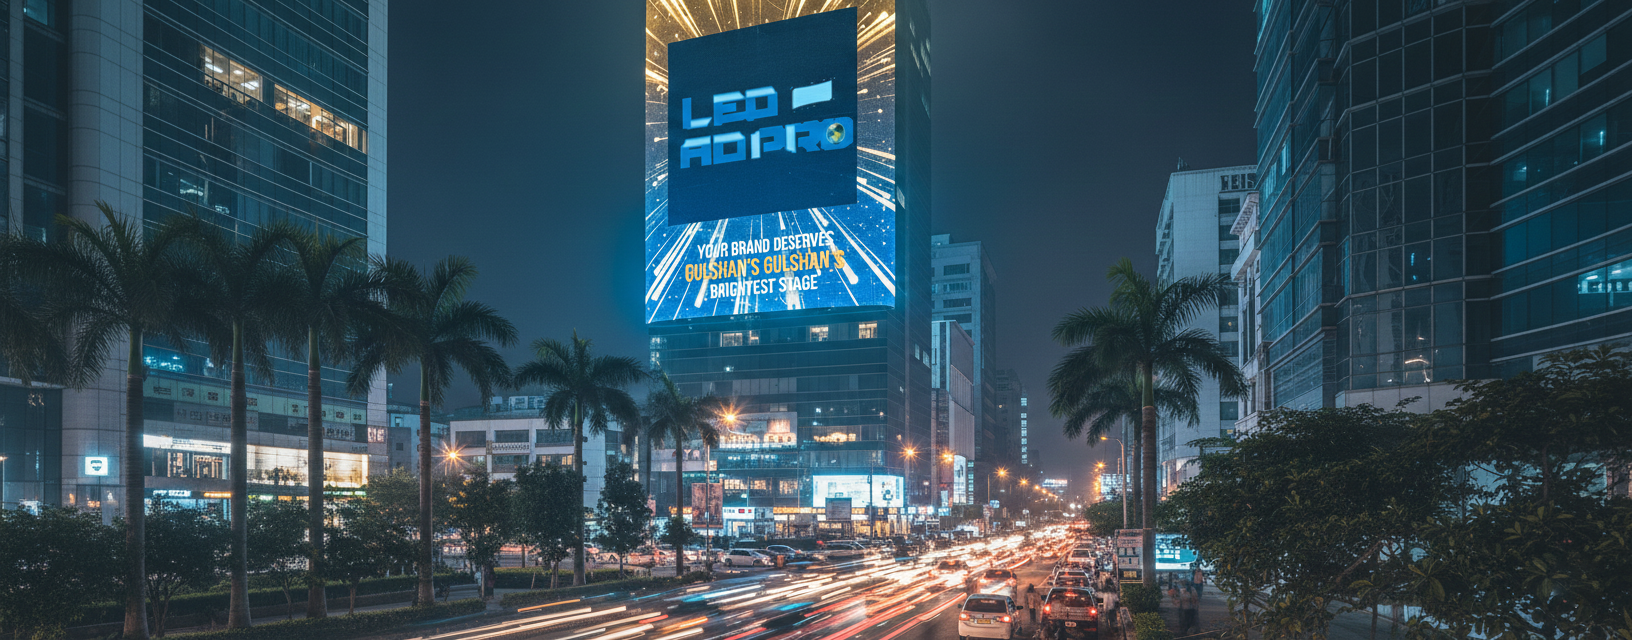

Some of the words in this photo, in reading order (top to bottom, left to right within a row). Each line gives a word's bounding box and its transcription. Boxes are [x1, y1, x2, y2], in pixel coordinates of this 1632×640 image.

[682, 86, 778, 129] LED
[680, 131, 746, 169] AD
[750, 116, 853, 159] PRO
[697, 243, 728, 259] YOUR
[731, 239, 770, 256] BRAND
[773, 231, 834, 251] DESERVES
[710, 278, 776, 299] BRIGHTEST
[778, 274, 818, 292] STAGE
